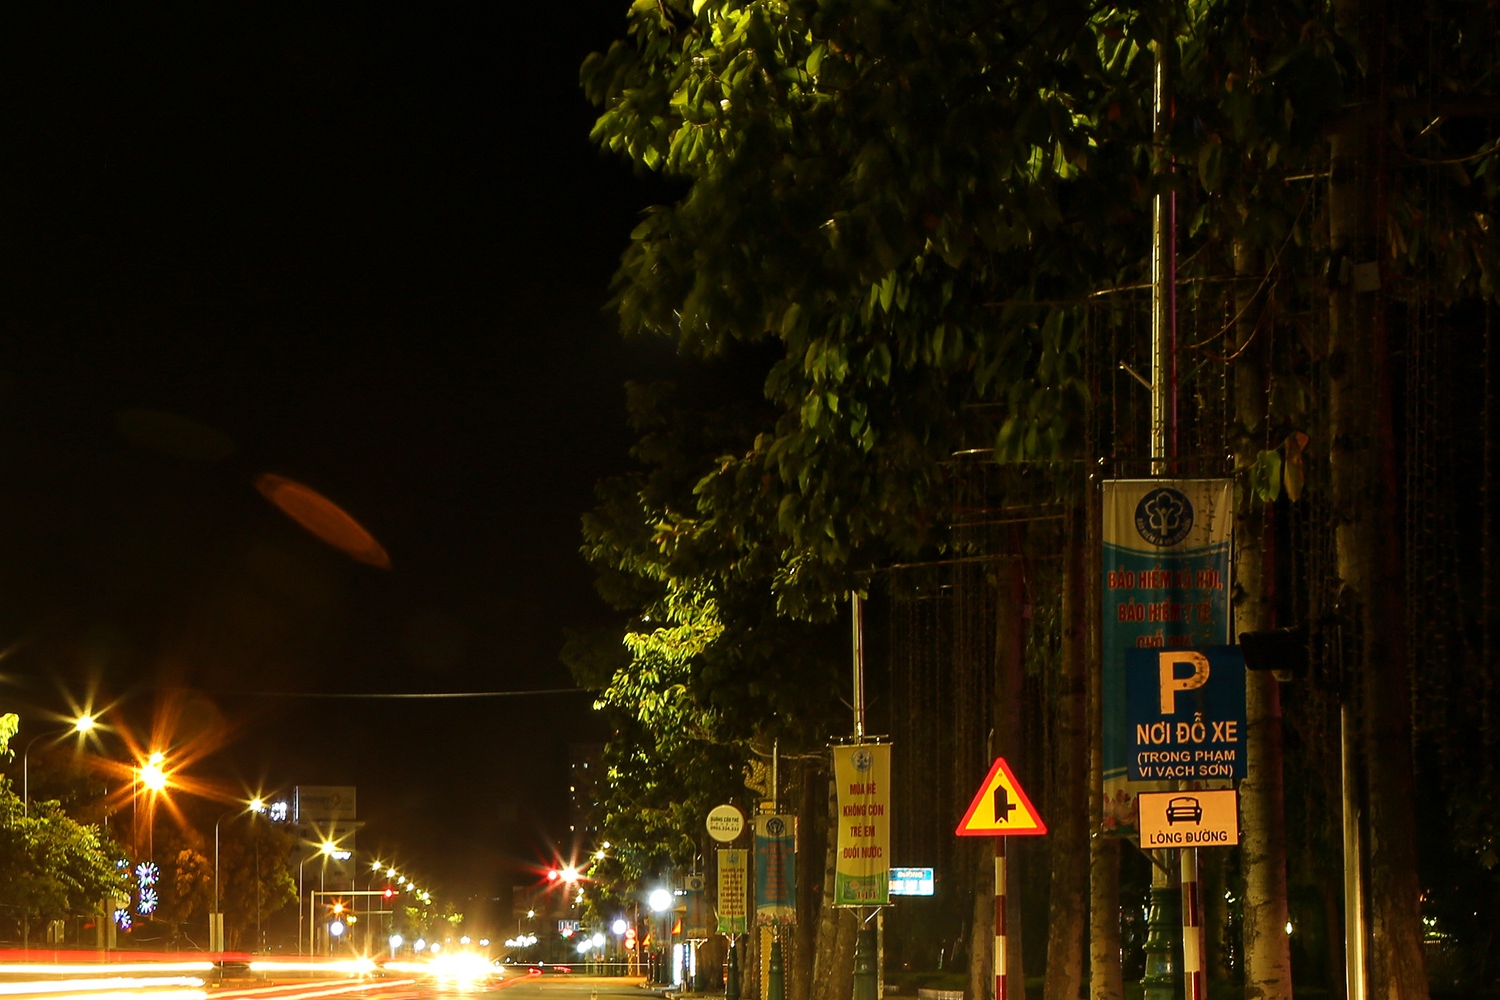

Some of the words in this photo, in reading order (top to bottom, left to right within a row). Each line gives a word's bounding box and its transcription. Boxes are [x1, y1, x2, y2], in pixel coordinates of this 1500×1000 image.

[1107, 564, 1135, 590] BẢO
[1138, 562, 1173, 590] HIỂM
[1118, 597, 1145, 622] BẢO
[1148, 596, 1182, 622] HIỂM
[1158, 650, 1211, 715] P
[1136, 721, 1171, 745] NƠI
[1175, 711, 1206, 745] ĐỖ
[1211, 720, 1238, 743] XE
[1137, 750, 1191, 765] (TRONG
[1195, 749, 1236, 764] PHẠM
[1139, 766, 1153, 778] VI
[1156, 765, 1195, 779] VẠCH
[1199, 763, 1234, 778] SƠN)
[850, 822, 862, 837] TRẺ
[864, 825, 875, 837] EM
[1150, 830, 1182, 844] LÒNG
[1185, 828, 1228, 843] ĐƯỜNG
[861, 845, 882, 858] NƯỚC
